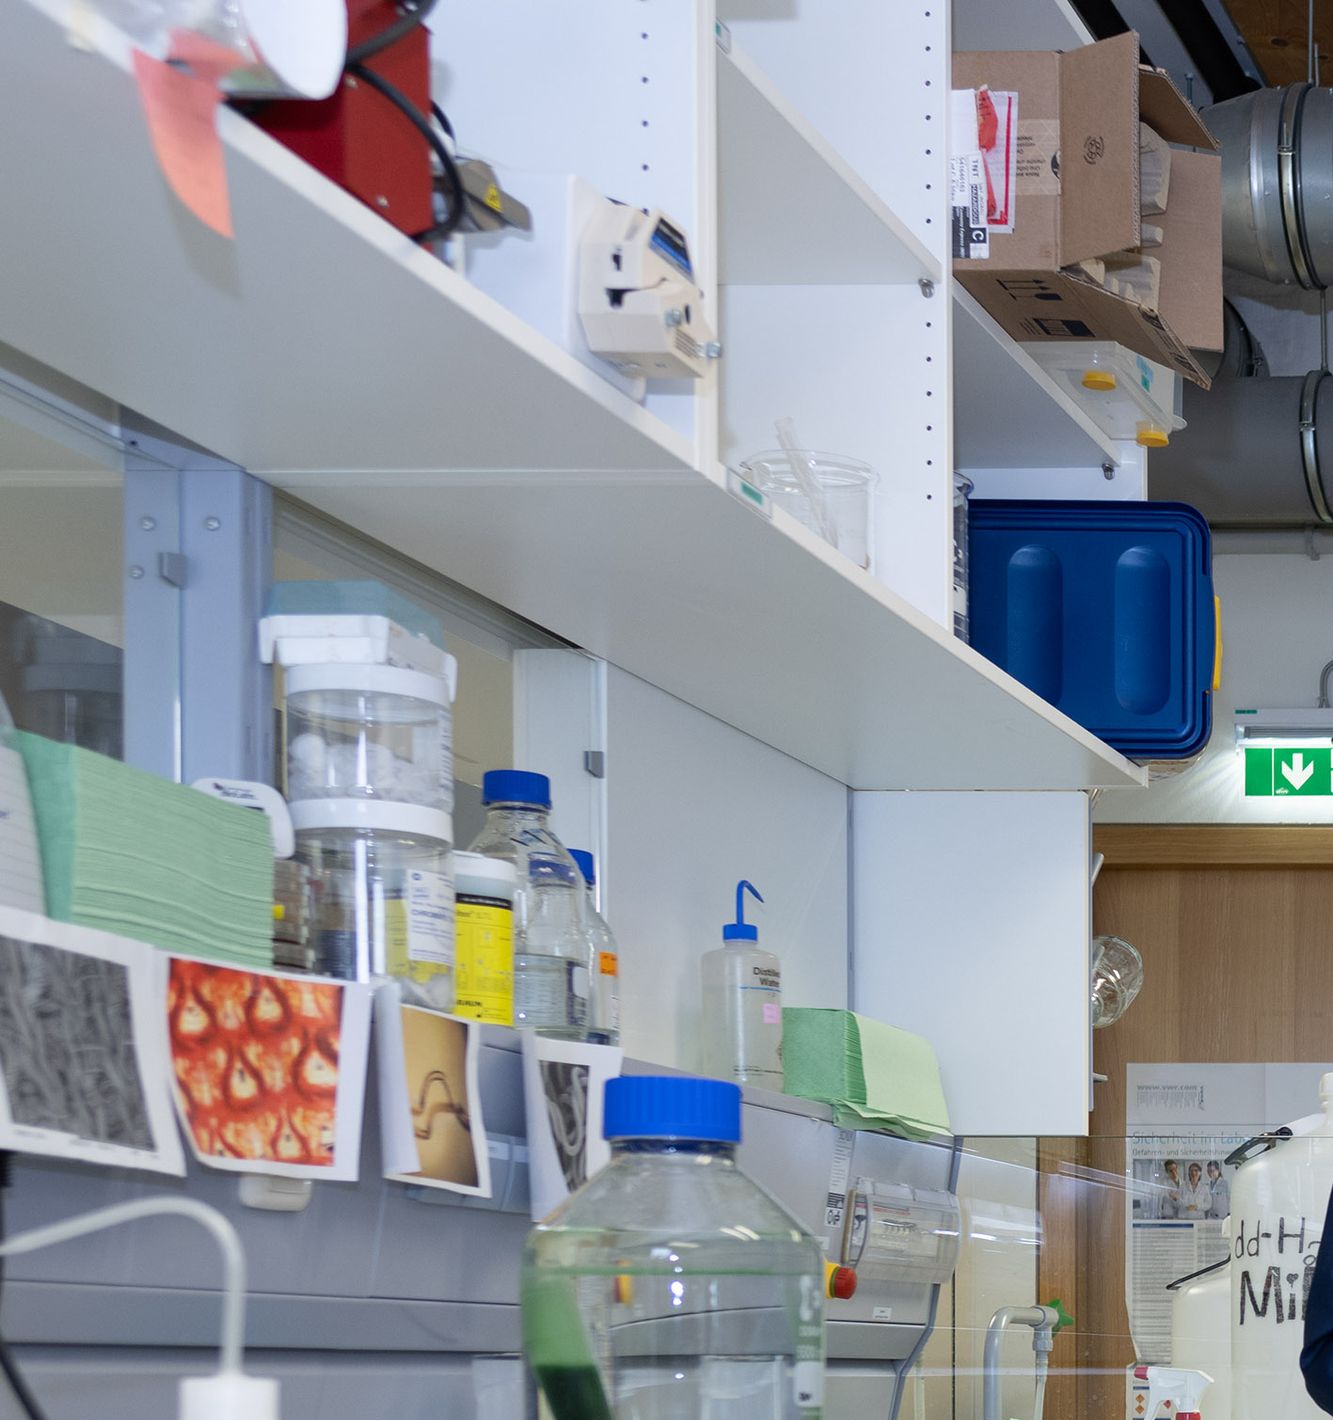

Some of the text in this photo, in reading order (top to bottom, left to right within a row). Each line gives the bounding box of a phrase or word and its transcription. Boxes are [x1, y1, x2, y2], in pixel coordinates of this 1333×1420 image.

[972, 230, 984, 241] C
[1132, 1131, 1198, 1145] Sicherheit
[1201, 1131, 1217, 1145] im
[1167, 1148, 1178, 1156] und
